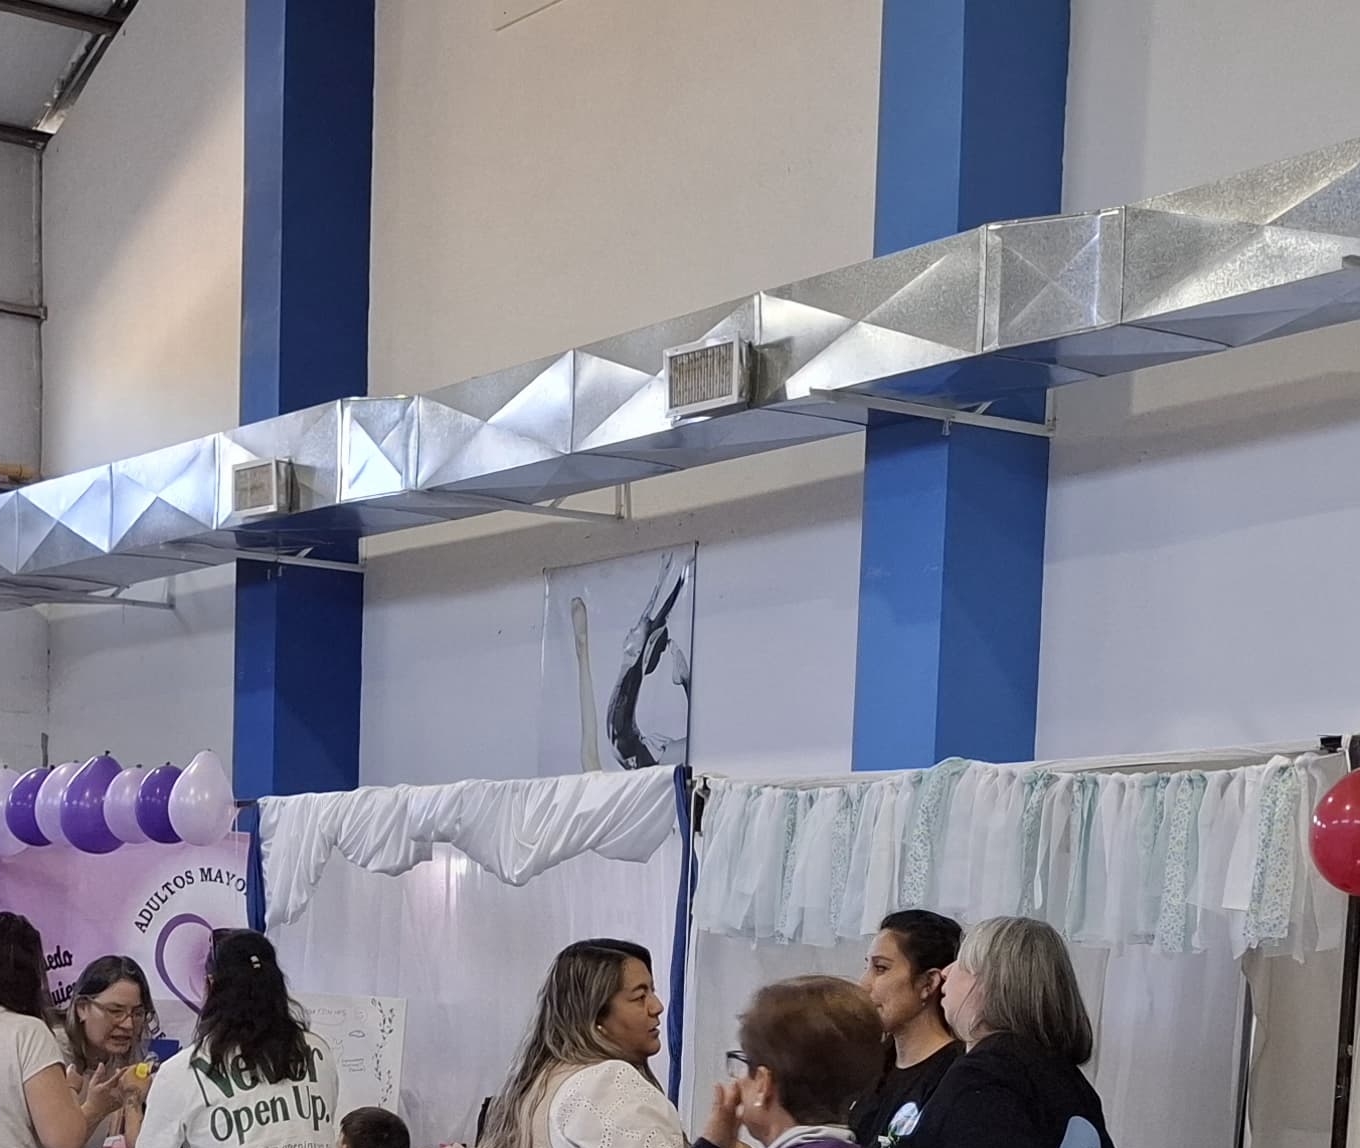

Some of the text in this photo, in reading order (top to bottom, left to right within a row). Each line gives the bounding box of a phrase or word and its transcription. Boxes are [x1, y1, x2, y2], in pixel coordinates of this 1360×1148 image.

[134, 866, 247, 934] ADULTOS MAYO
[210, 1085, 330, 1146] Open Up.
